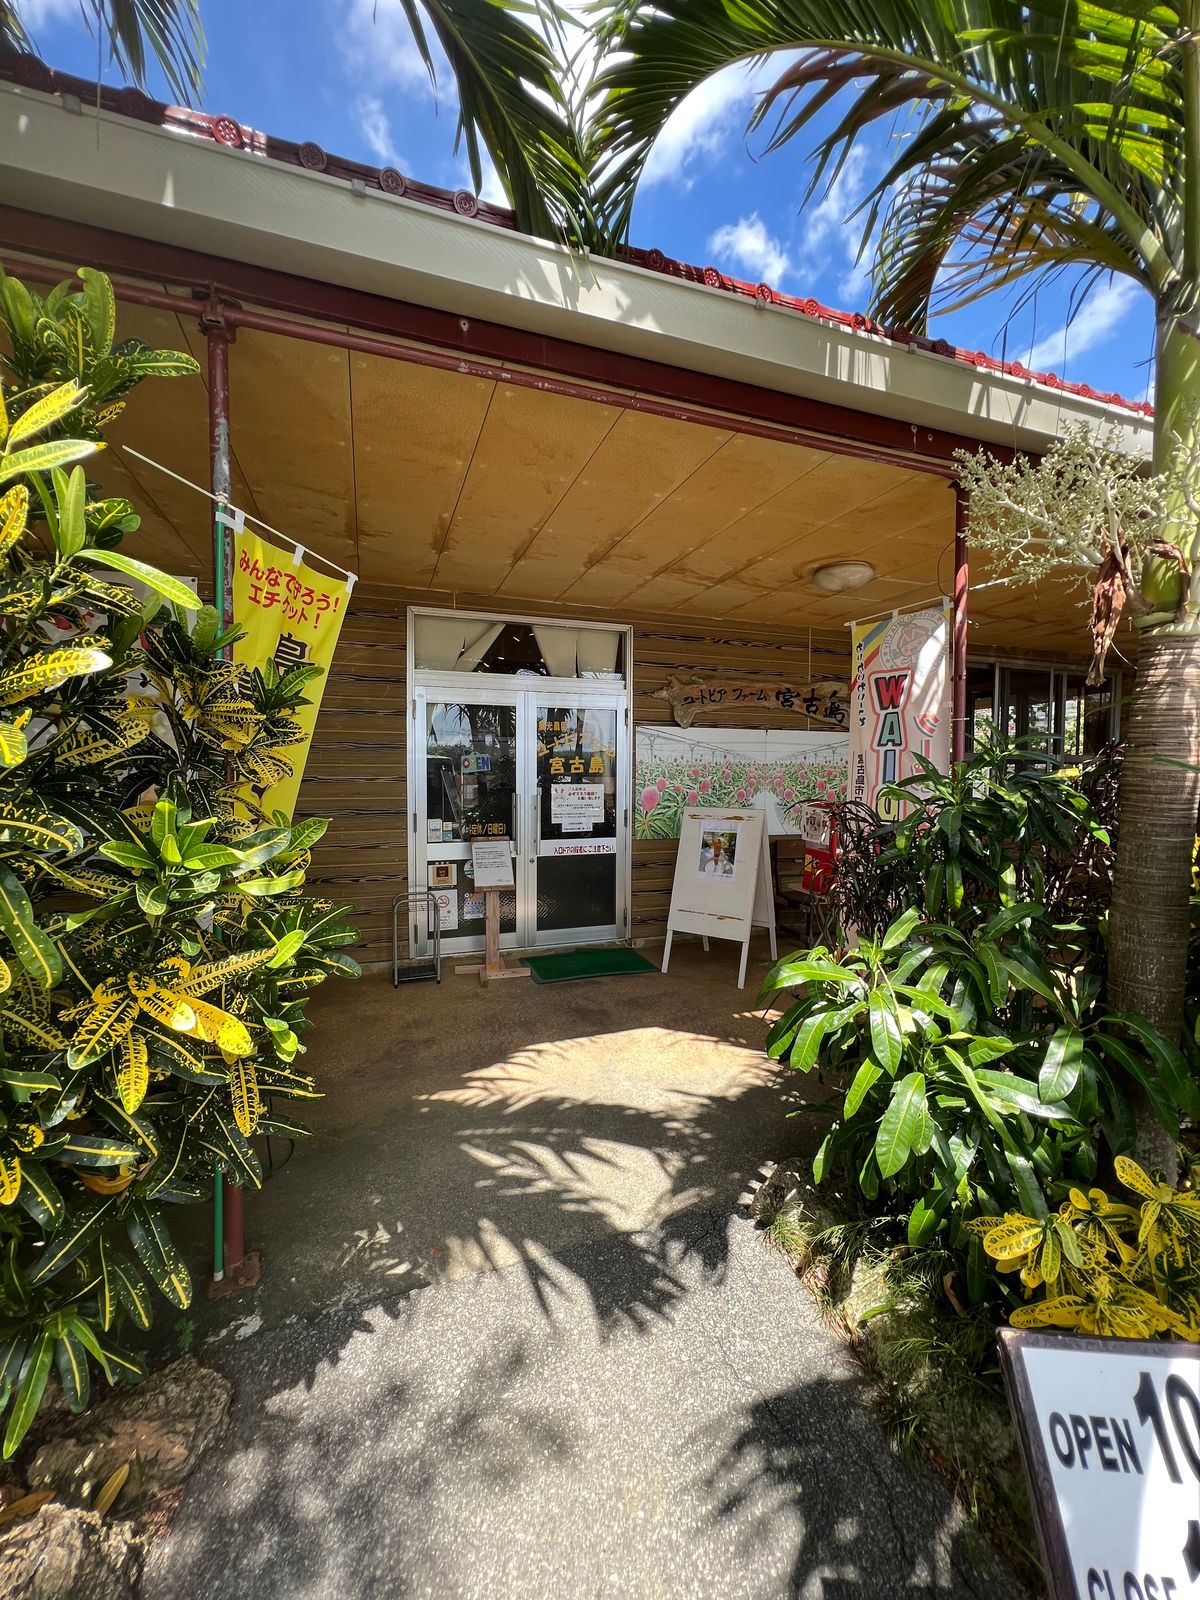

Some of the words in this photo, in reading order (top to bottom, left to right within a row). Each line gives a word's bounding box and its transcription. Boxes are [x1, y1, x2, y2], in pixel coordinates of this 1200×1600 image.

[463, 756, 490, 769] OPEN
[549, 756, 605, 774] 宮古島
[1048, 1411, 1144, 1475] OPEN
